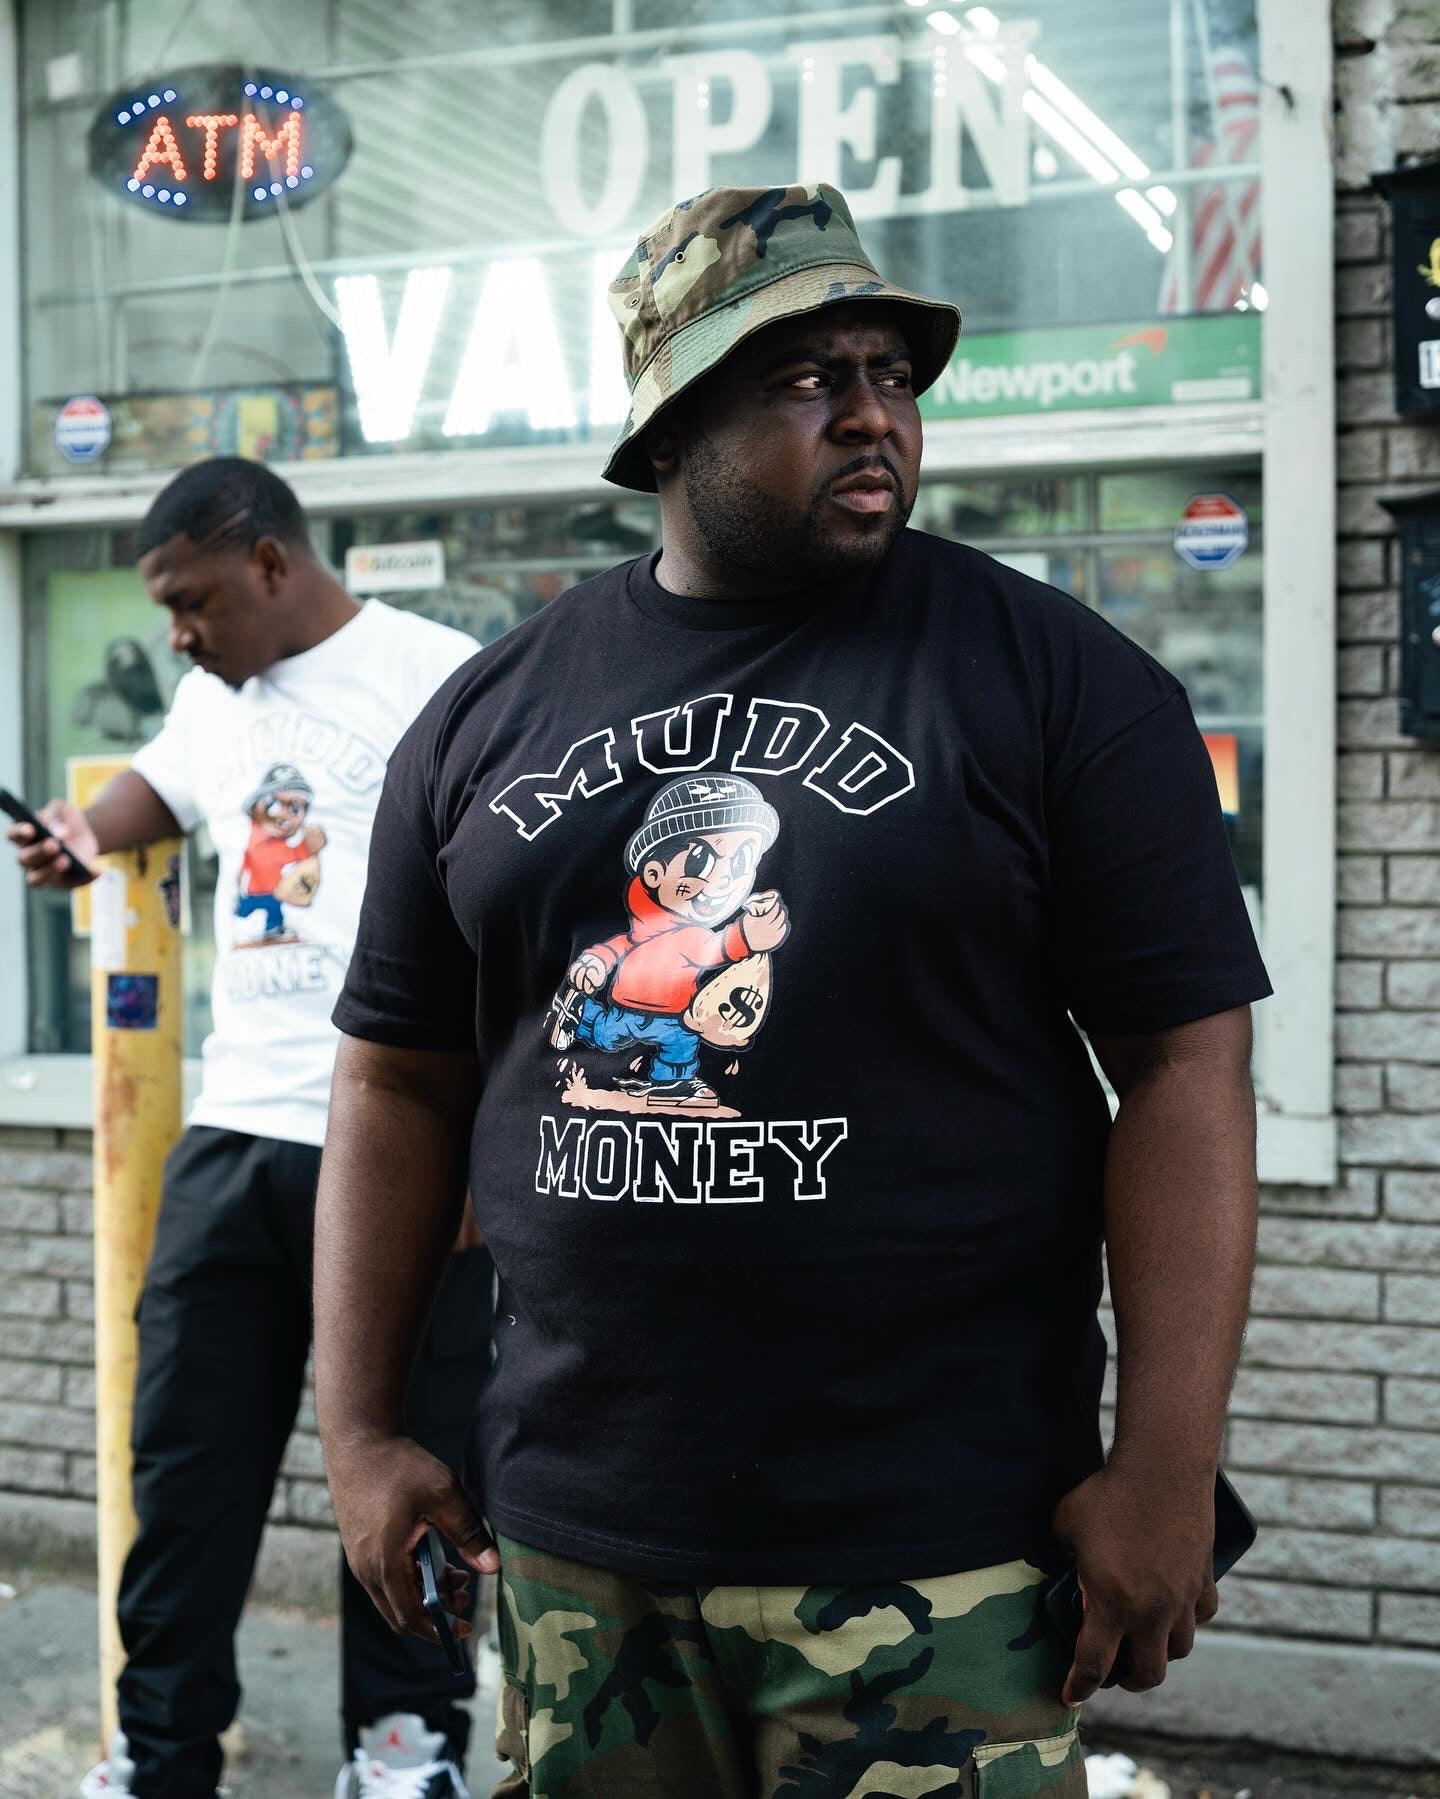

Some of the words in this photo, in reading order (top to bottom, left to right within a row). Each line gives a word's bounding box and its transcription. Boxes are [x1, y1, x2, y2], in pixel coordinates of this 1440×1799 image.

[131, 110, 304, 181] ATM
[540, 18, 1040, 235] OPEN
[933, 352, 1138, 408] Newport
[213, 709, 388, 797] UDD
[489, 693, 916, 842] MUDD
[225, 941, 351, 1002] ONE
[535, 1115, 848, 1204] MONEY
